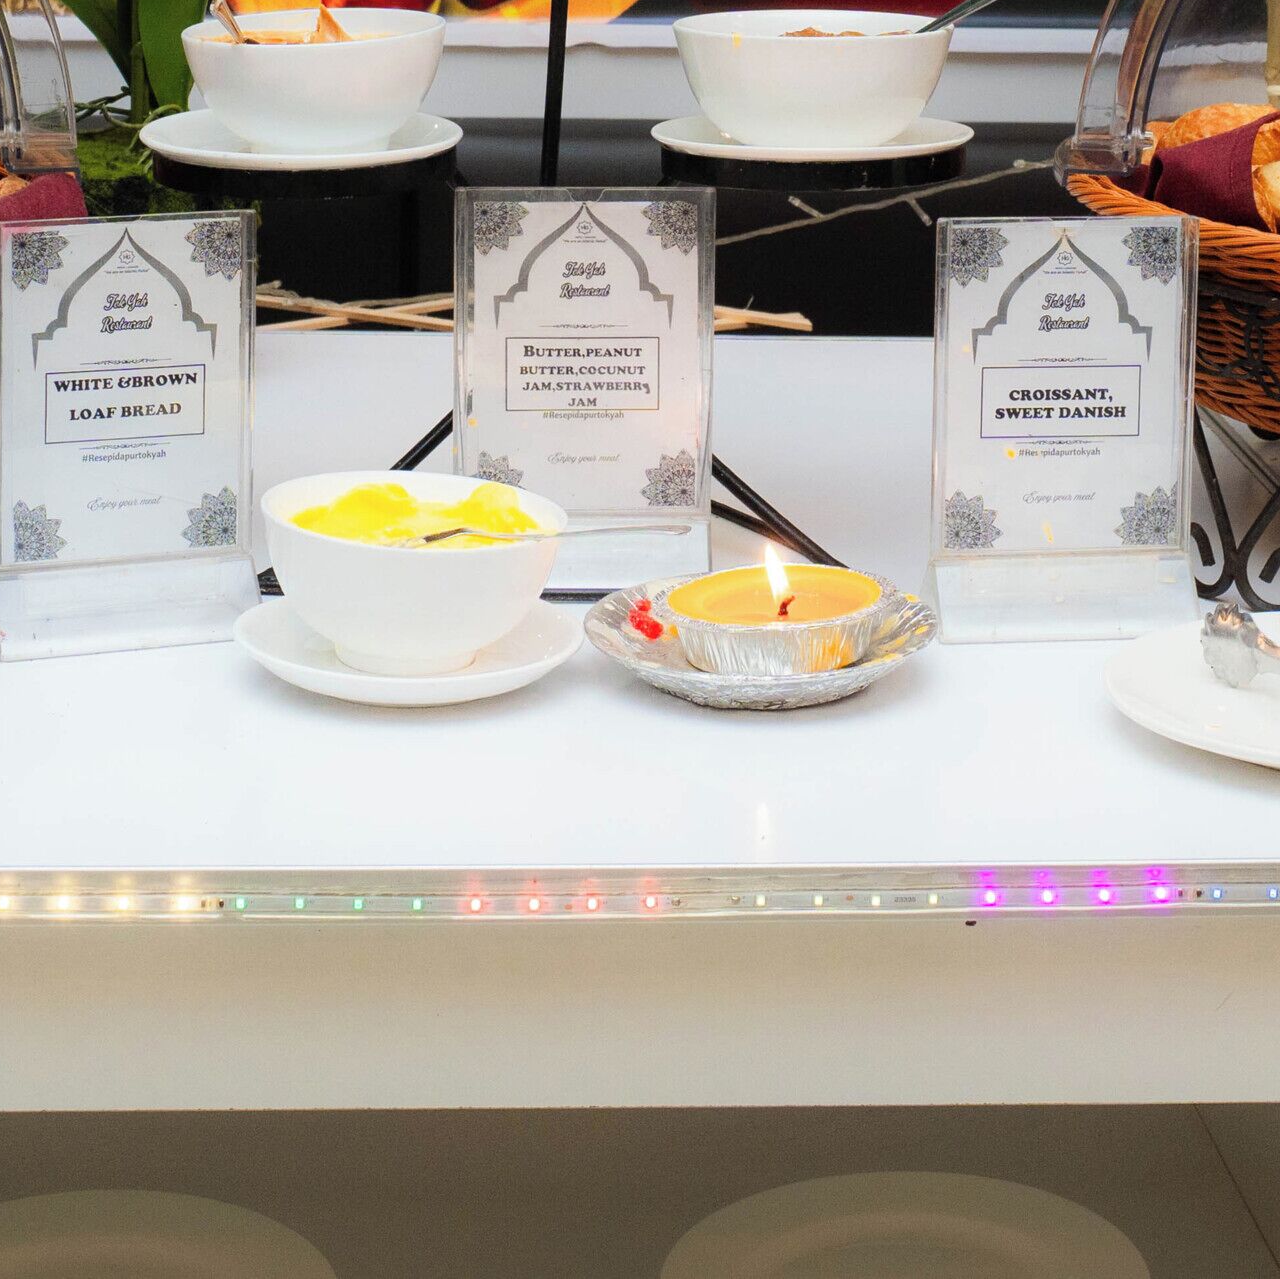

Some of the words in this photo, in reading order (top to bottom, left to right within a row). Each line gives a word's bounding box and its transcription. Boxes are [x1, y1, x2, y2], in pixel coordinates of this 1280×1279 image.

[54, 378, 113, 392] WHITE
[117, 373, 198, 389] &BROWN
[1009, 388, 1113, 402] CROISSANT,
[568, 398, 598, 407] JAM
[70, 407, 117, 421] LOAF
[121, 403, 182, 417] BREAD
[995, 407, 1054, 419] SWEET
[1059, 406, 1126, 418] DANISH
[82, 450, 166, 463] #Resepidapurtokyah
[1019, 447, 1100, 458] #Repidapurtokyah
